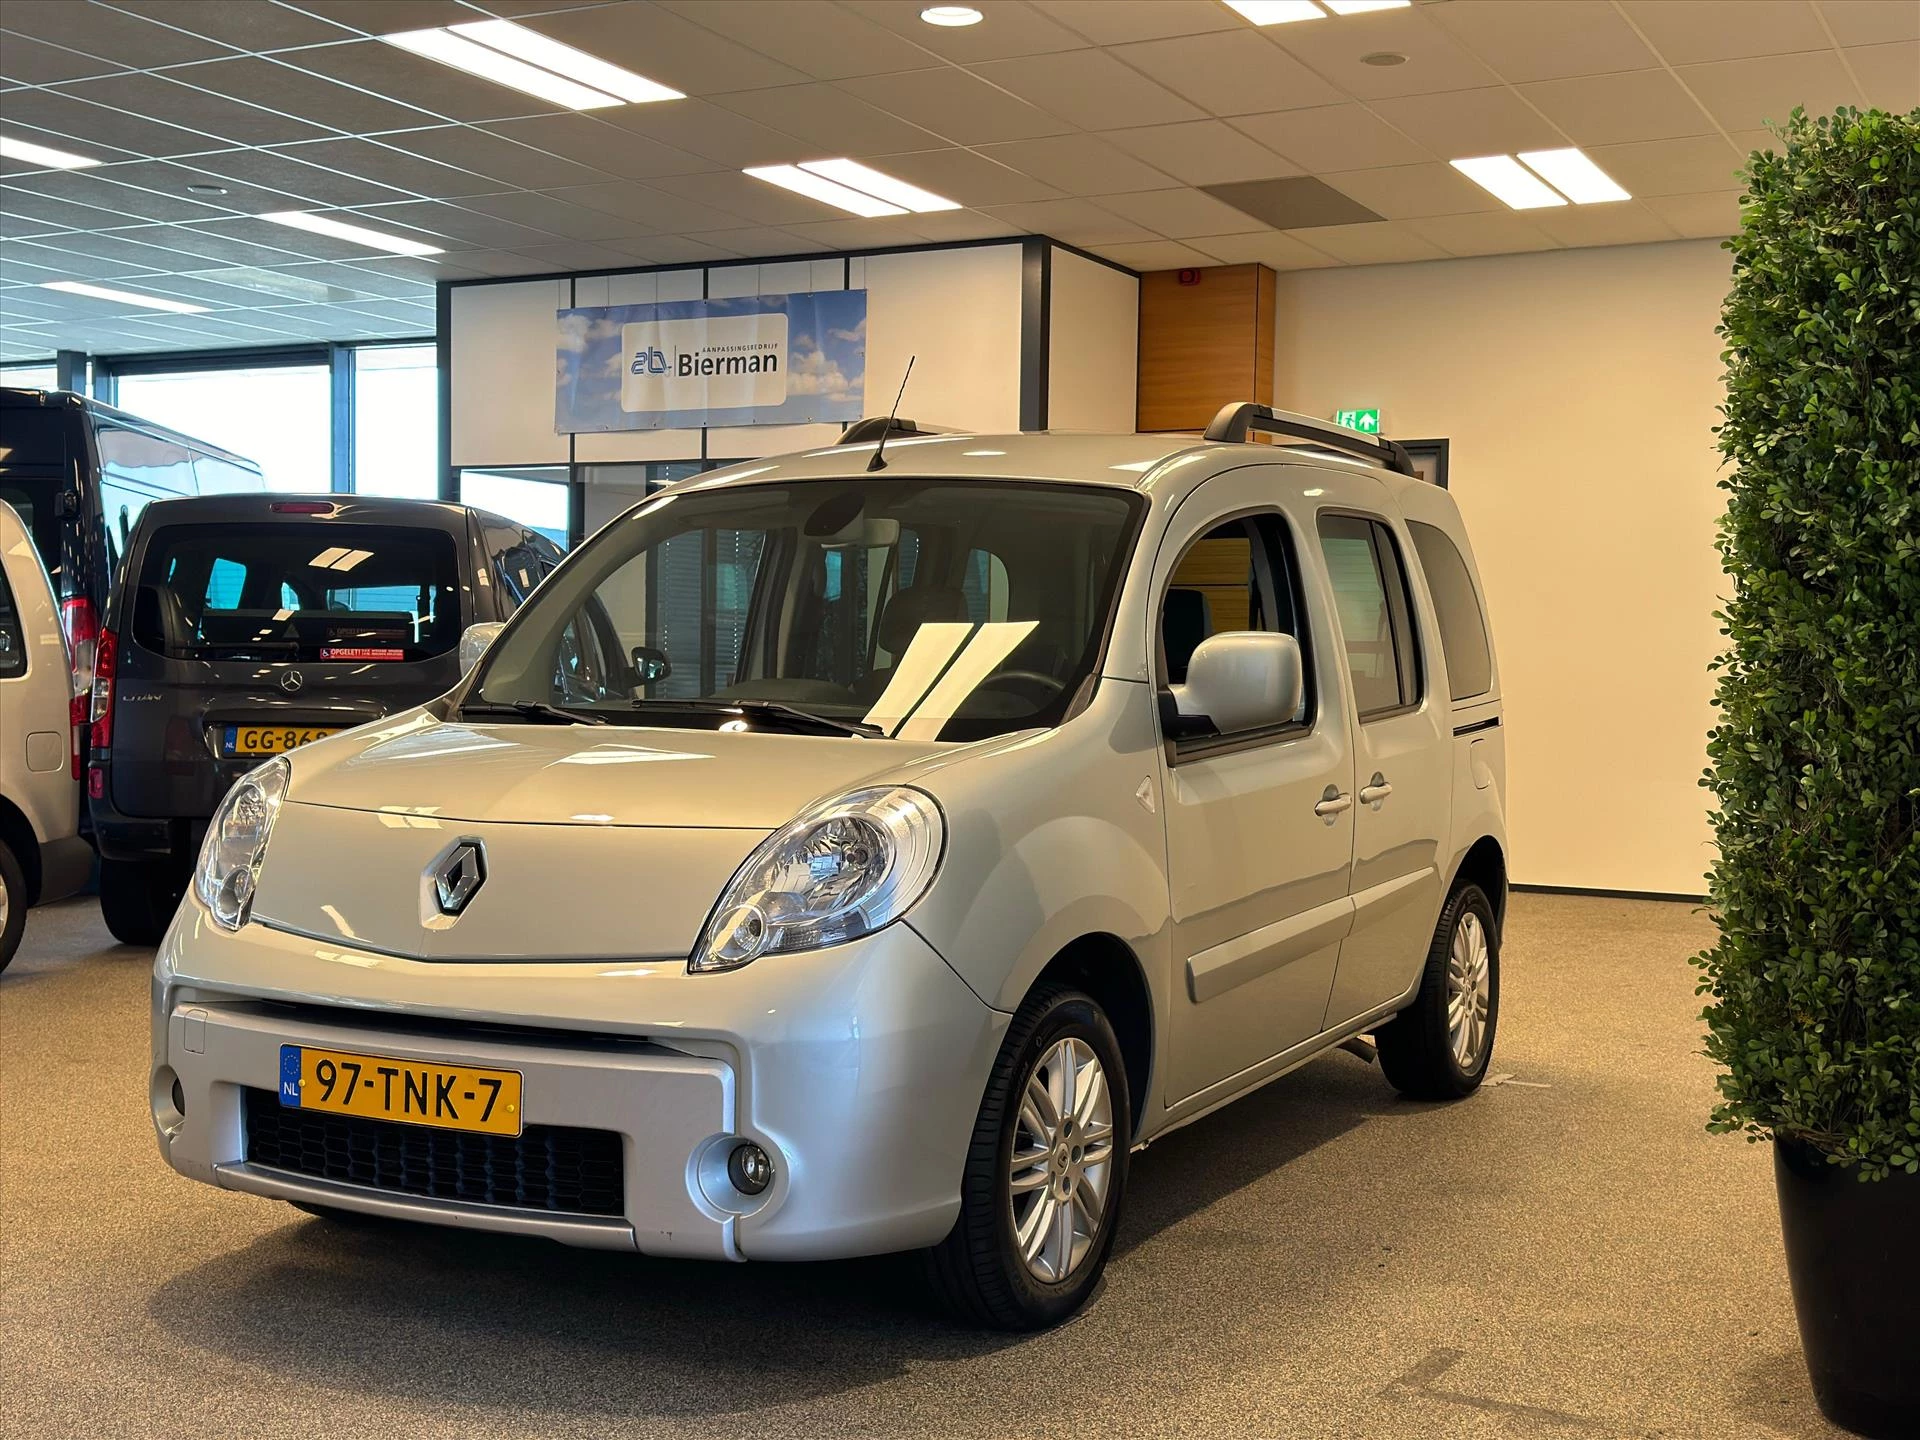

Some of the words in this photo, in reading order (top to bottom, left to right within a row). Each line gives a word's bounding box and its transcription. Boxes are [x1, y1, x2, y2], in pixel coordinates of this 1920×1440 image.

[702, 343, 778, 353] AANPASSINGSBEDRIJF
[678, 352, 777, 377] Bierman
[283, 1082, 299, 1097] NL
[315, 1059, 503, 1122] 97-TNK-7
